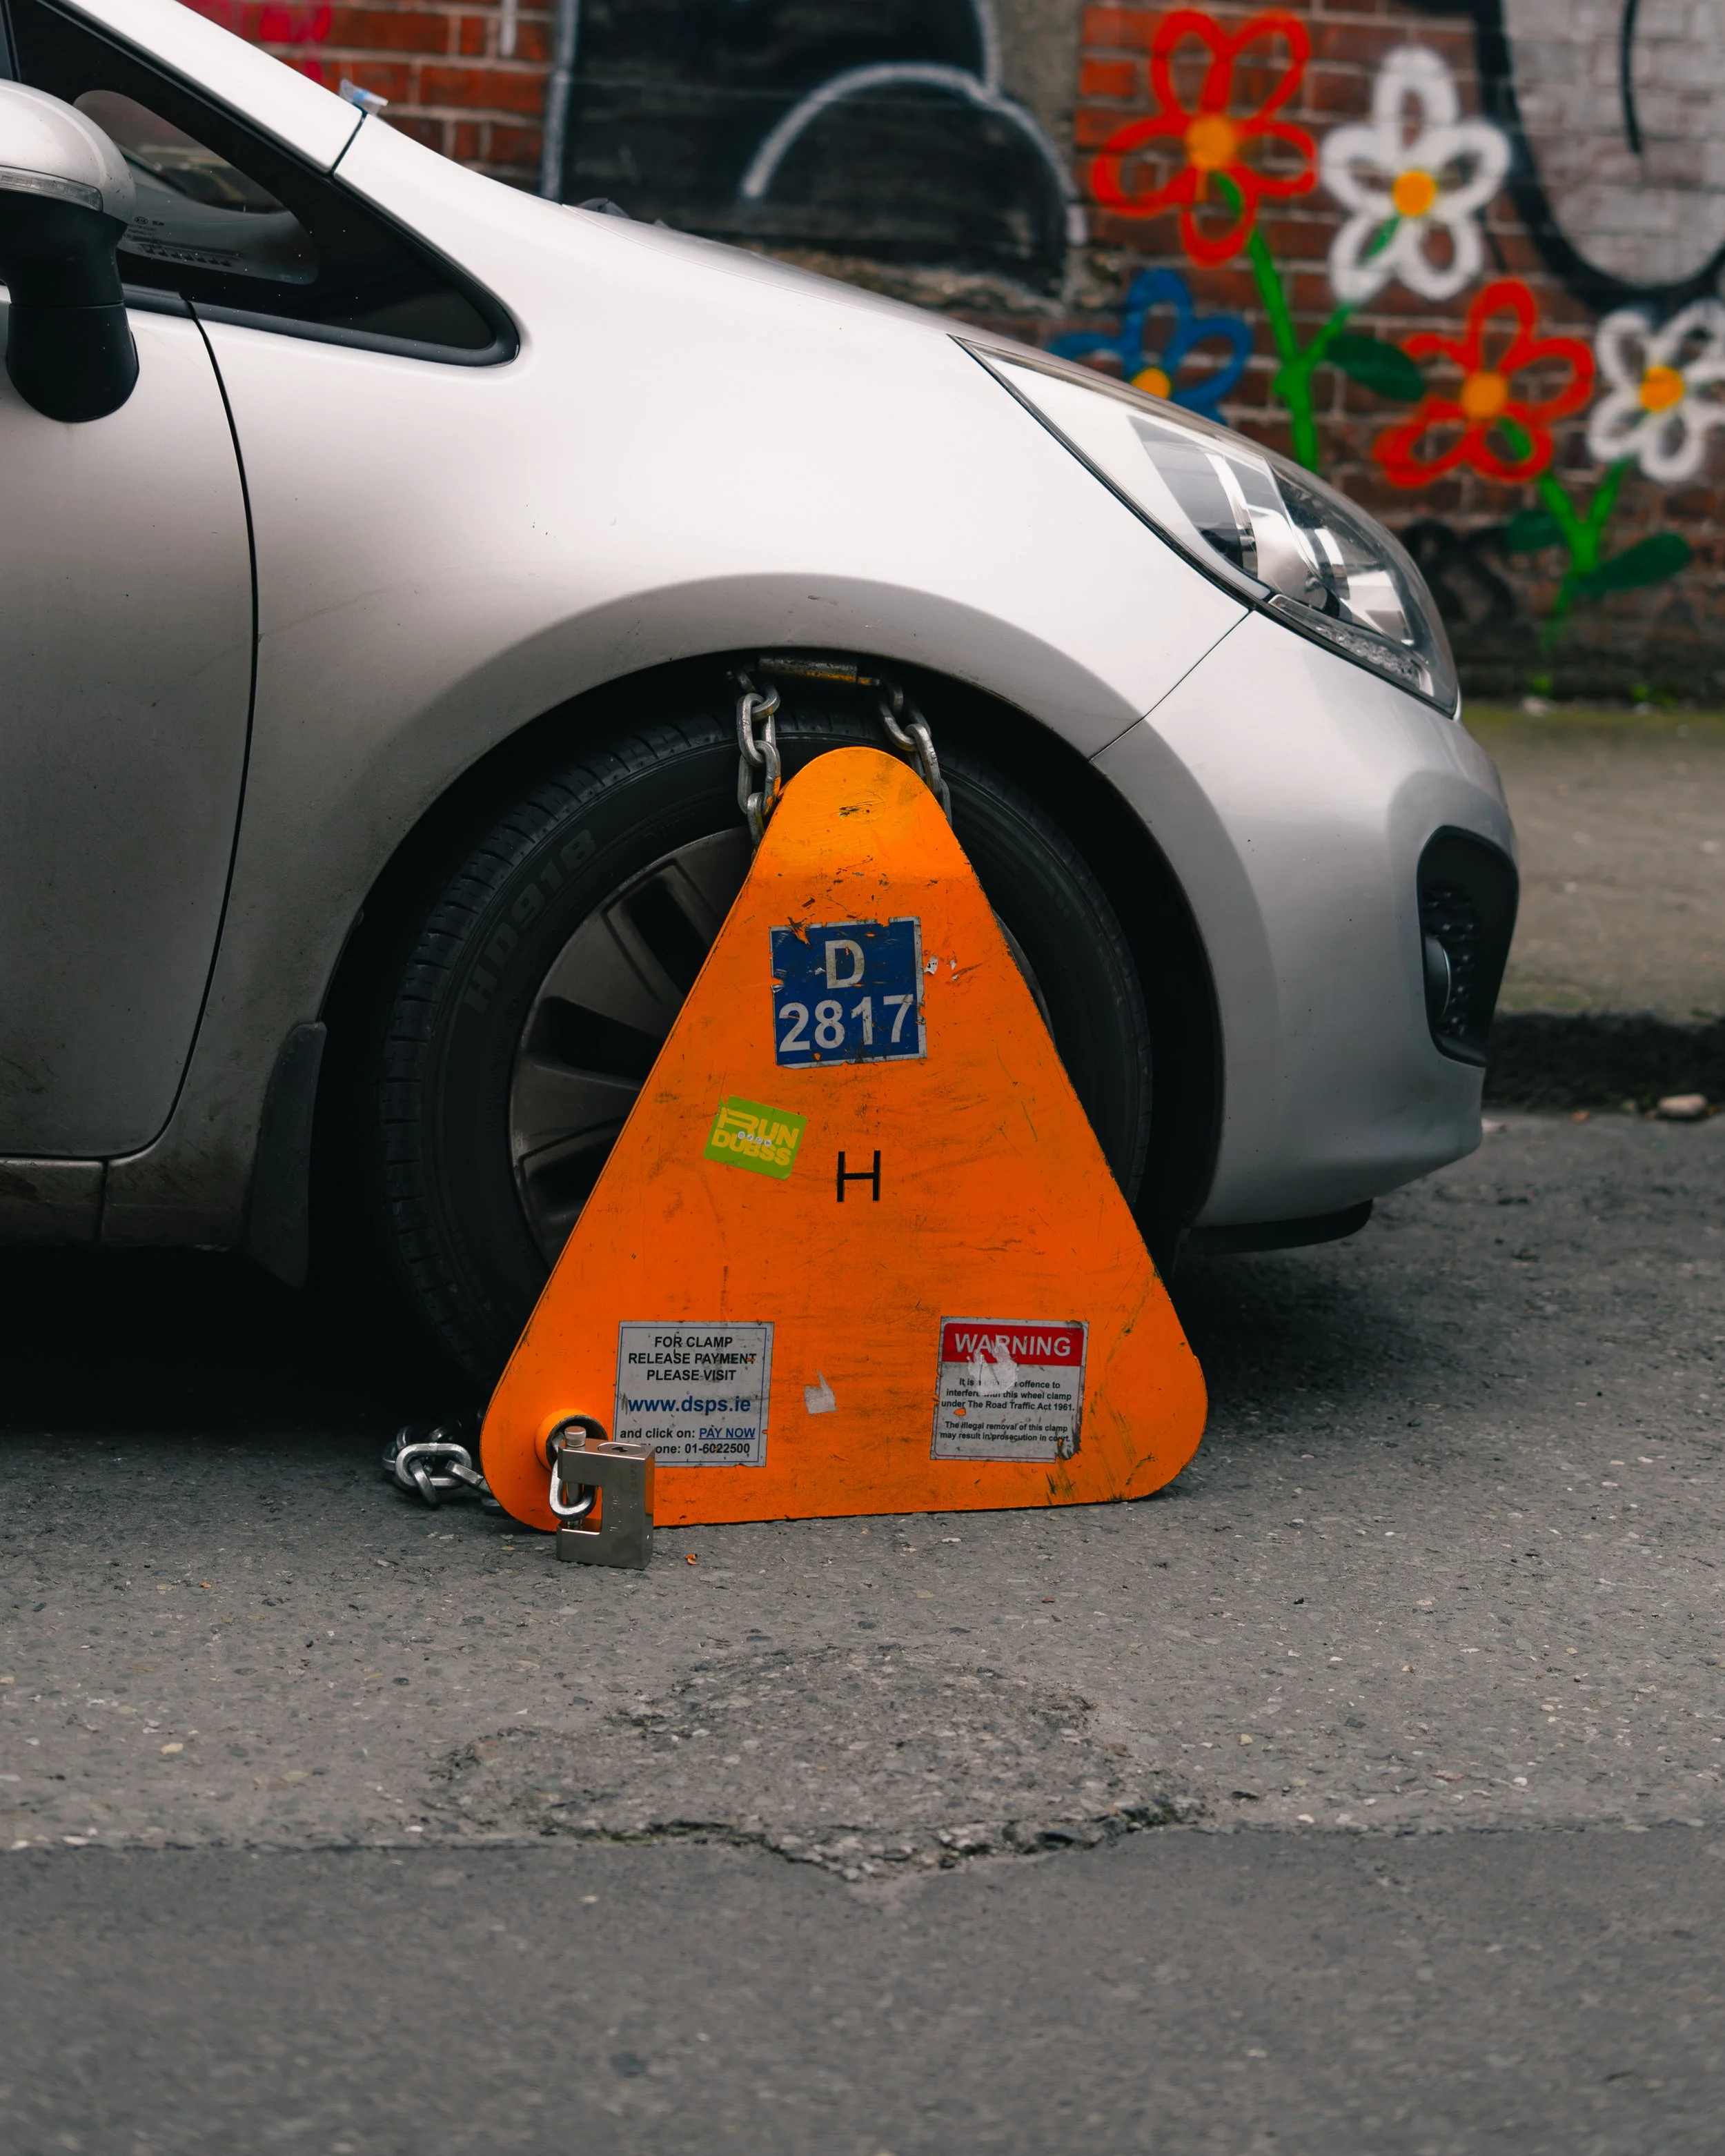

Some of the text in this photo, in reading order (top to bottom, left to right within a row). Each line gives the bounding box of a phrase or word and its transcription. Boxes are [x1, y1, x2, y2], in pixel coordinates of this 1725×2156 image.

[464, 829, 598, 1016] HD918
[825, 939, 865, 989] D
[778, 993, 914, 1052] 2817
[718, 1107, 799, 1149] RUN
[711, 1128, 792, 1166] DUBSS
[836, 1150, 881, 1202] H
[655, 1336, 733, 1347] FOR CLAMP
[955, 1333, 1071, 1357] WARNING
[628, 1353, 756, 1364] RELEASE PAYMENT
[647, 1369, 736, 1381] PLEASE VISIT
[959, 1378, 966, 1386] It
[967, 1378, 974, 1386] is
[1003, 1389, 1018, 1398] this
[1021, 1391, 1045, 1399] wheel
[1047, 1392, 1072, 1401] clamp
[628, 1395, 751, 1416] www.dsps.ie
[620, 1427, 756, 1439] and click on: PAY NOW
[961, 1421, 984, 1430] illegal
[1045, 1424, 1068, 1433] clamp
[940, 1432, 956, 1441] may
[992, 1432, 1037, 1443] prosecution
[640, 1443, 750, 1454] one: 01-6022500
